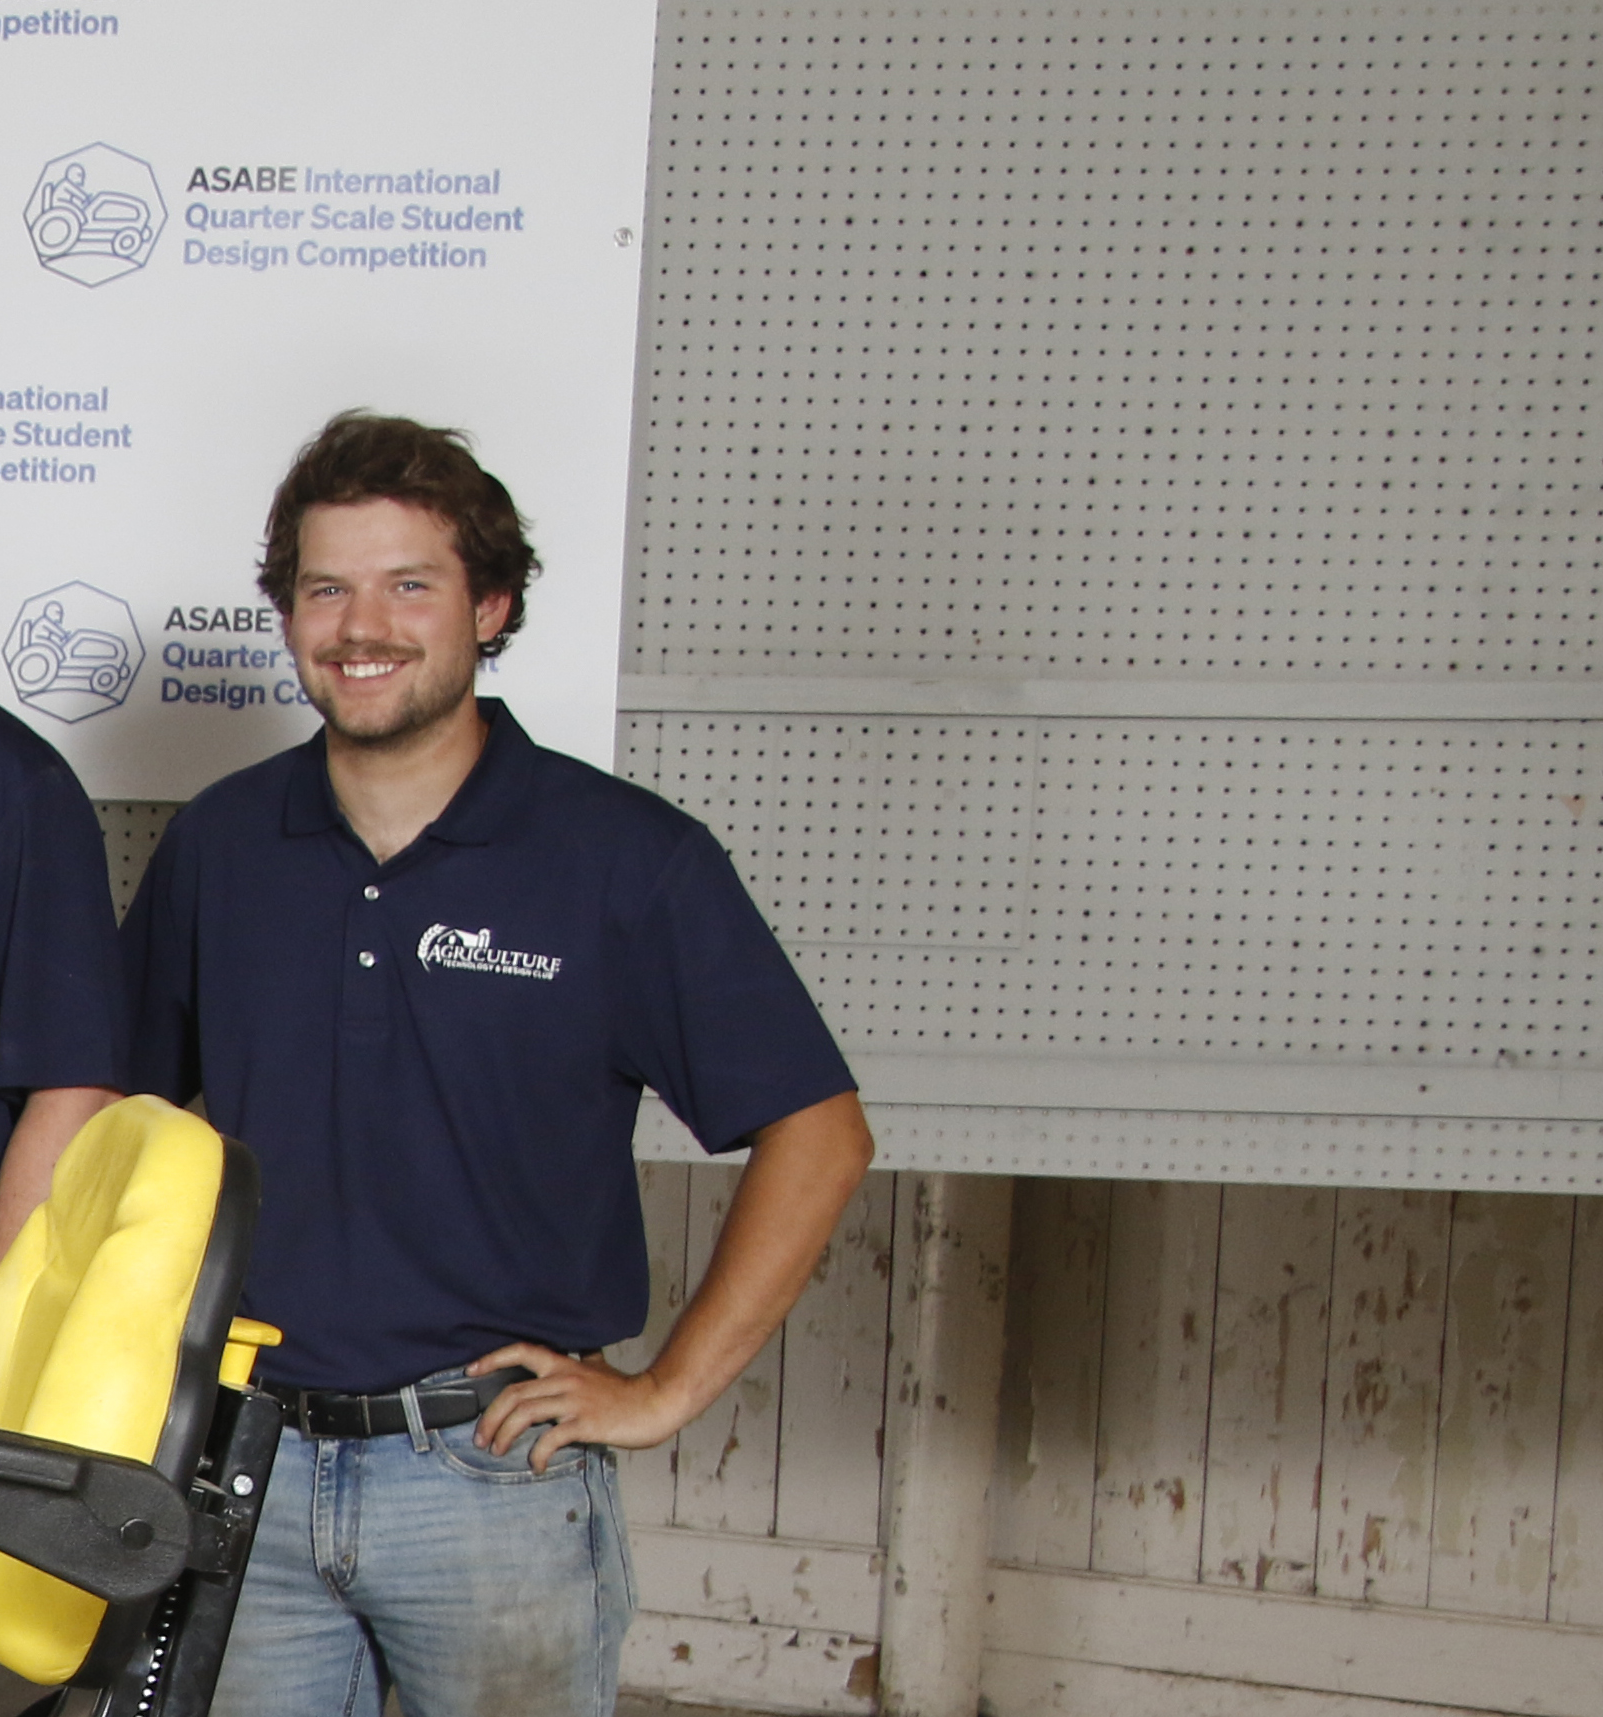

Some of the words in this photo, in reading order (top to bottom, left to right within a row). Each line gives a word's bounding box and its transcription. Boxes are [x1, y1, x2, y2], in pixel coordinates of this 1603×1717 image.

[186, 166, 297, 193] ASABE
[305, 167, 500, 194] International
[185, 202, 305, 232] Quarter
[311, 203, 395, 230] Scale
[401, 204, 524, 231] Student
[184, 239, 288, 271] Design
[296, 240, 486, 272] Competition
[13, 421, 132, 447] Student
[164, 606, 274, 632] ASABE
[163, 641, 281, 669] Quarter
[161, 678, 265, 709] Design
[427, 943, 562, 973] AGRICULTURE
[442, 959, 494, 972] TECHNOLOGY
[502, 965, 532, 978] DESIGN
